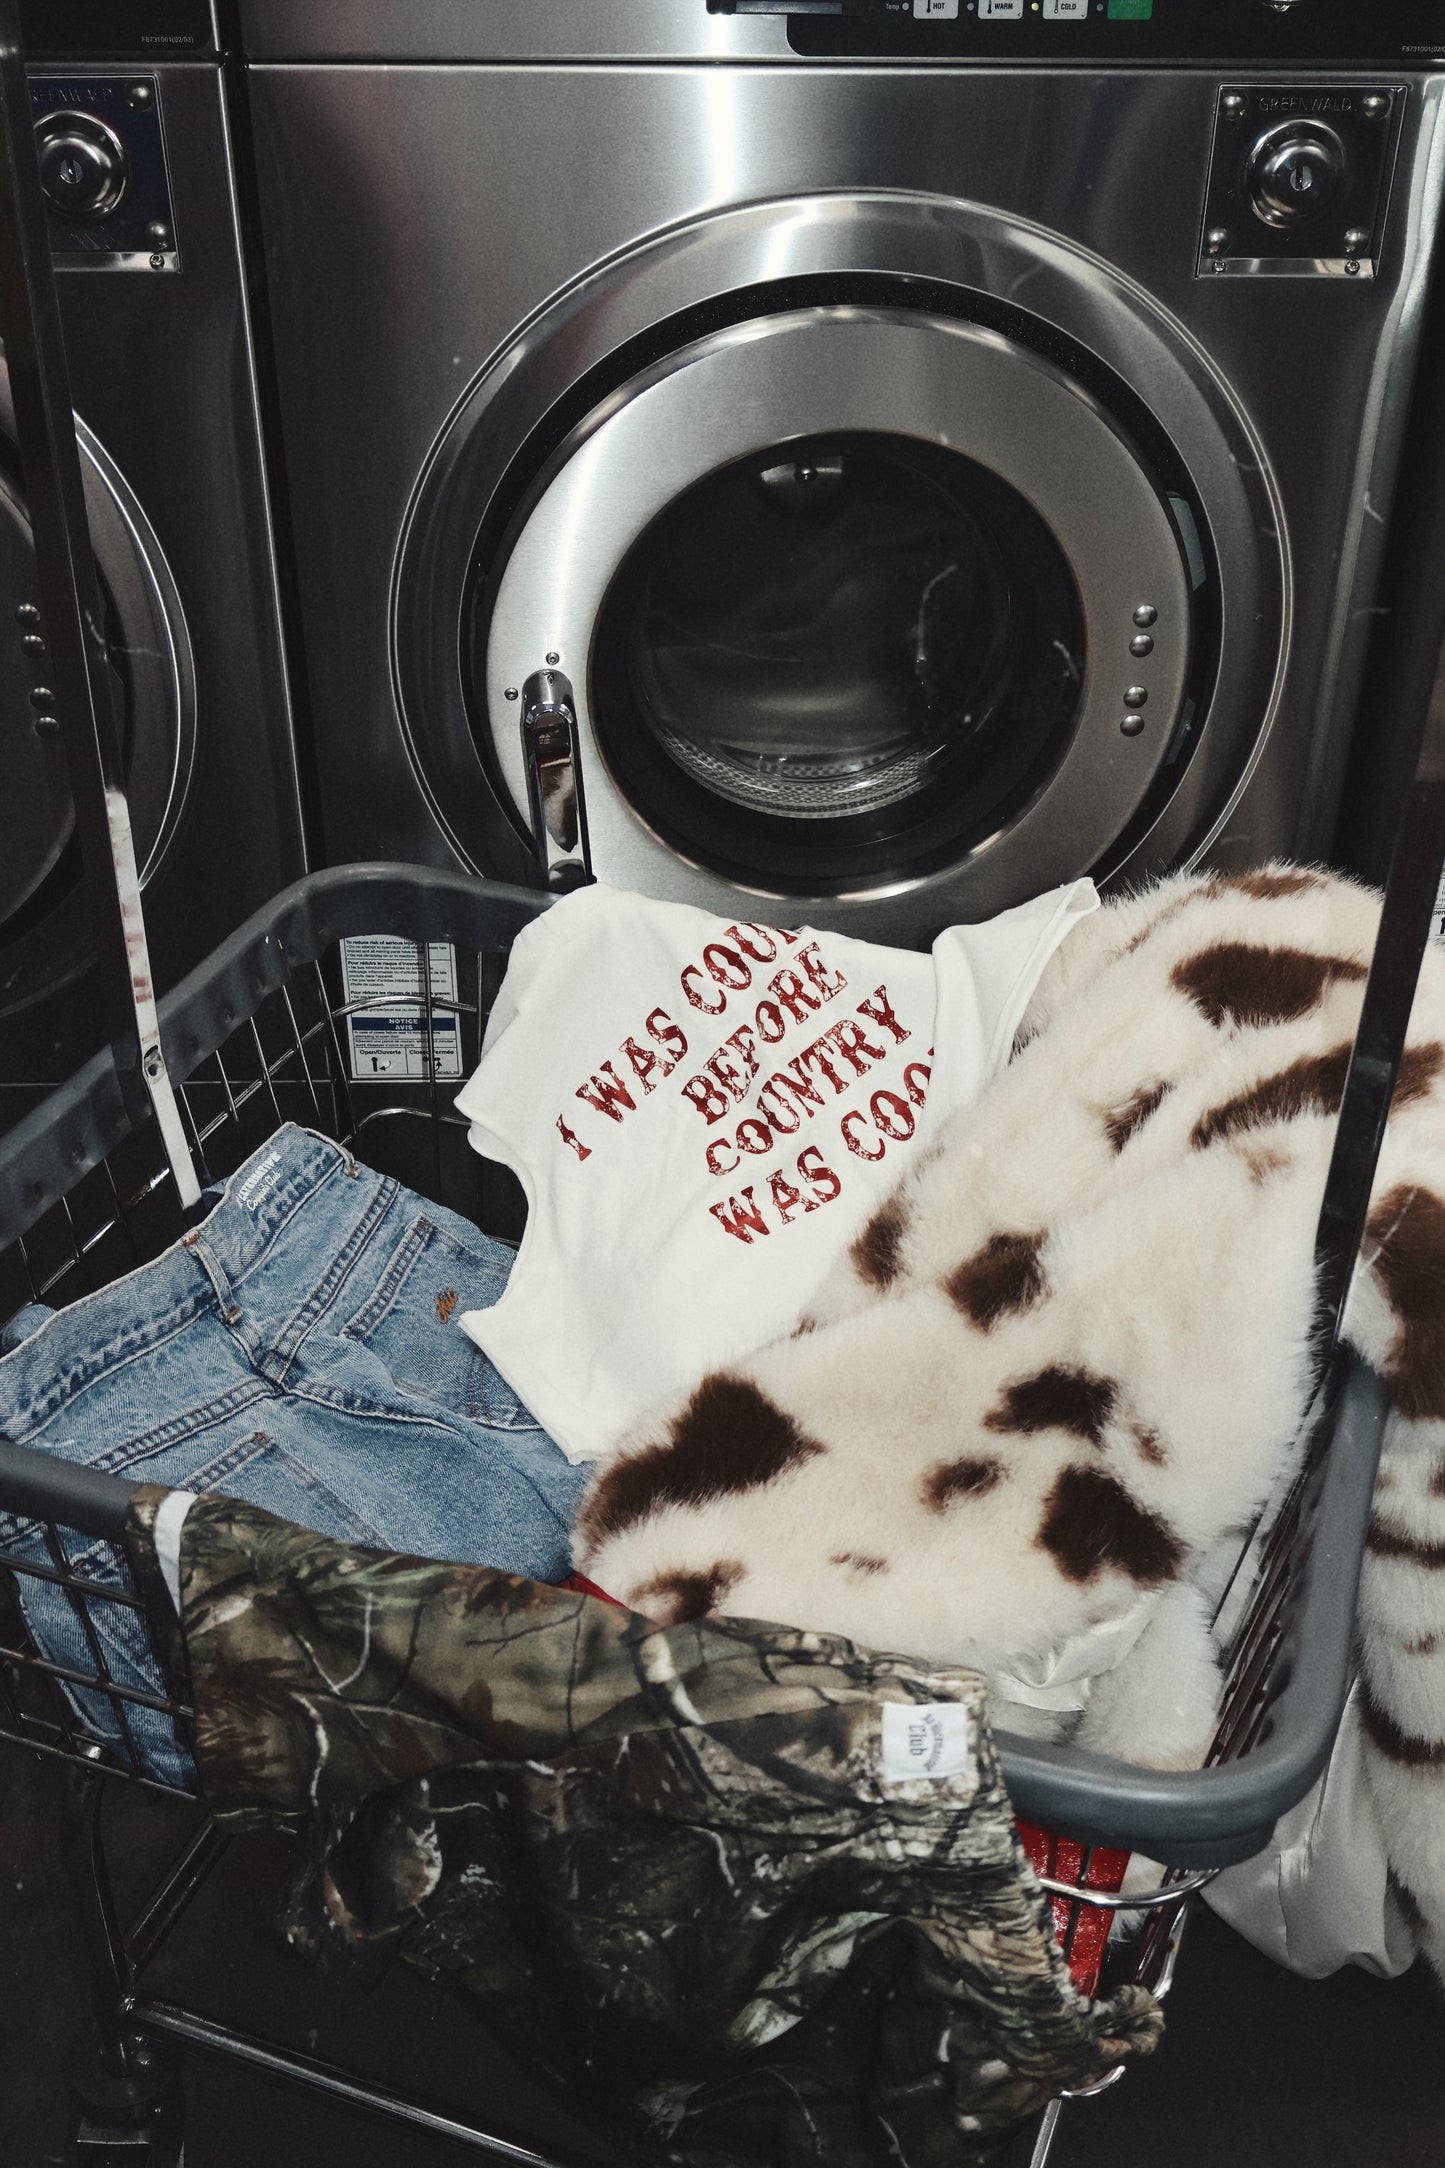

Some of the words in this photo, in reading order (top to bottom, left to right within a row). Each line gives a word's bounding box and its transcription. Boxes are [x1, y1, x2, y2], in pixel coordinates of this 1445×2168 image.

[1259, 96, 1353, 112] GREENWALD
[555, 1113, 593, 1162] I
[575, 1007, 689, 1123] WAS
[680, 941, 847, 1126] BEFORE
[705, 984, 912, 1176] COUNTRY
[709, 1145, 842, 1245] WAS
[840, 1047, 935, 1162] COO
[908, 1724, 927, 1756] Club
